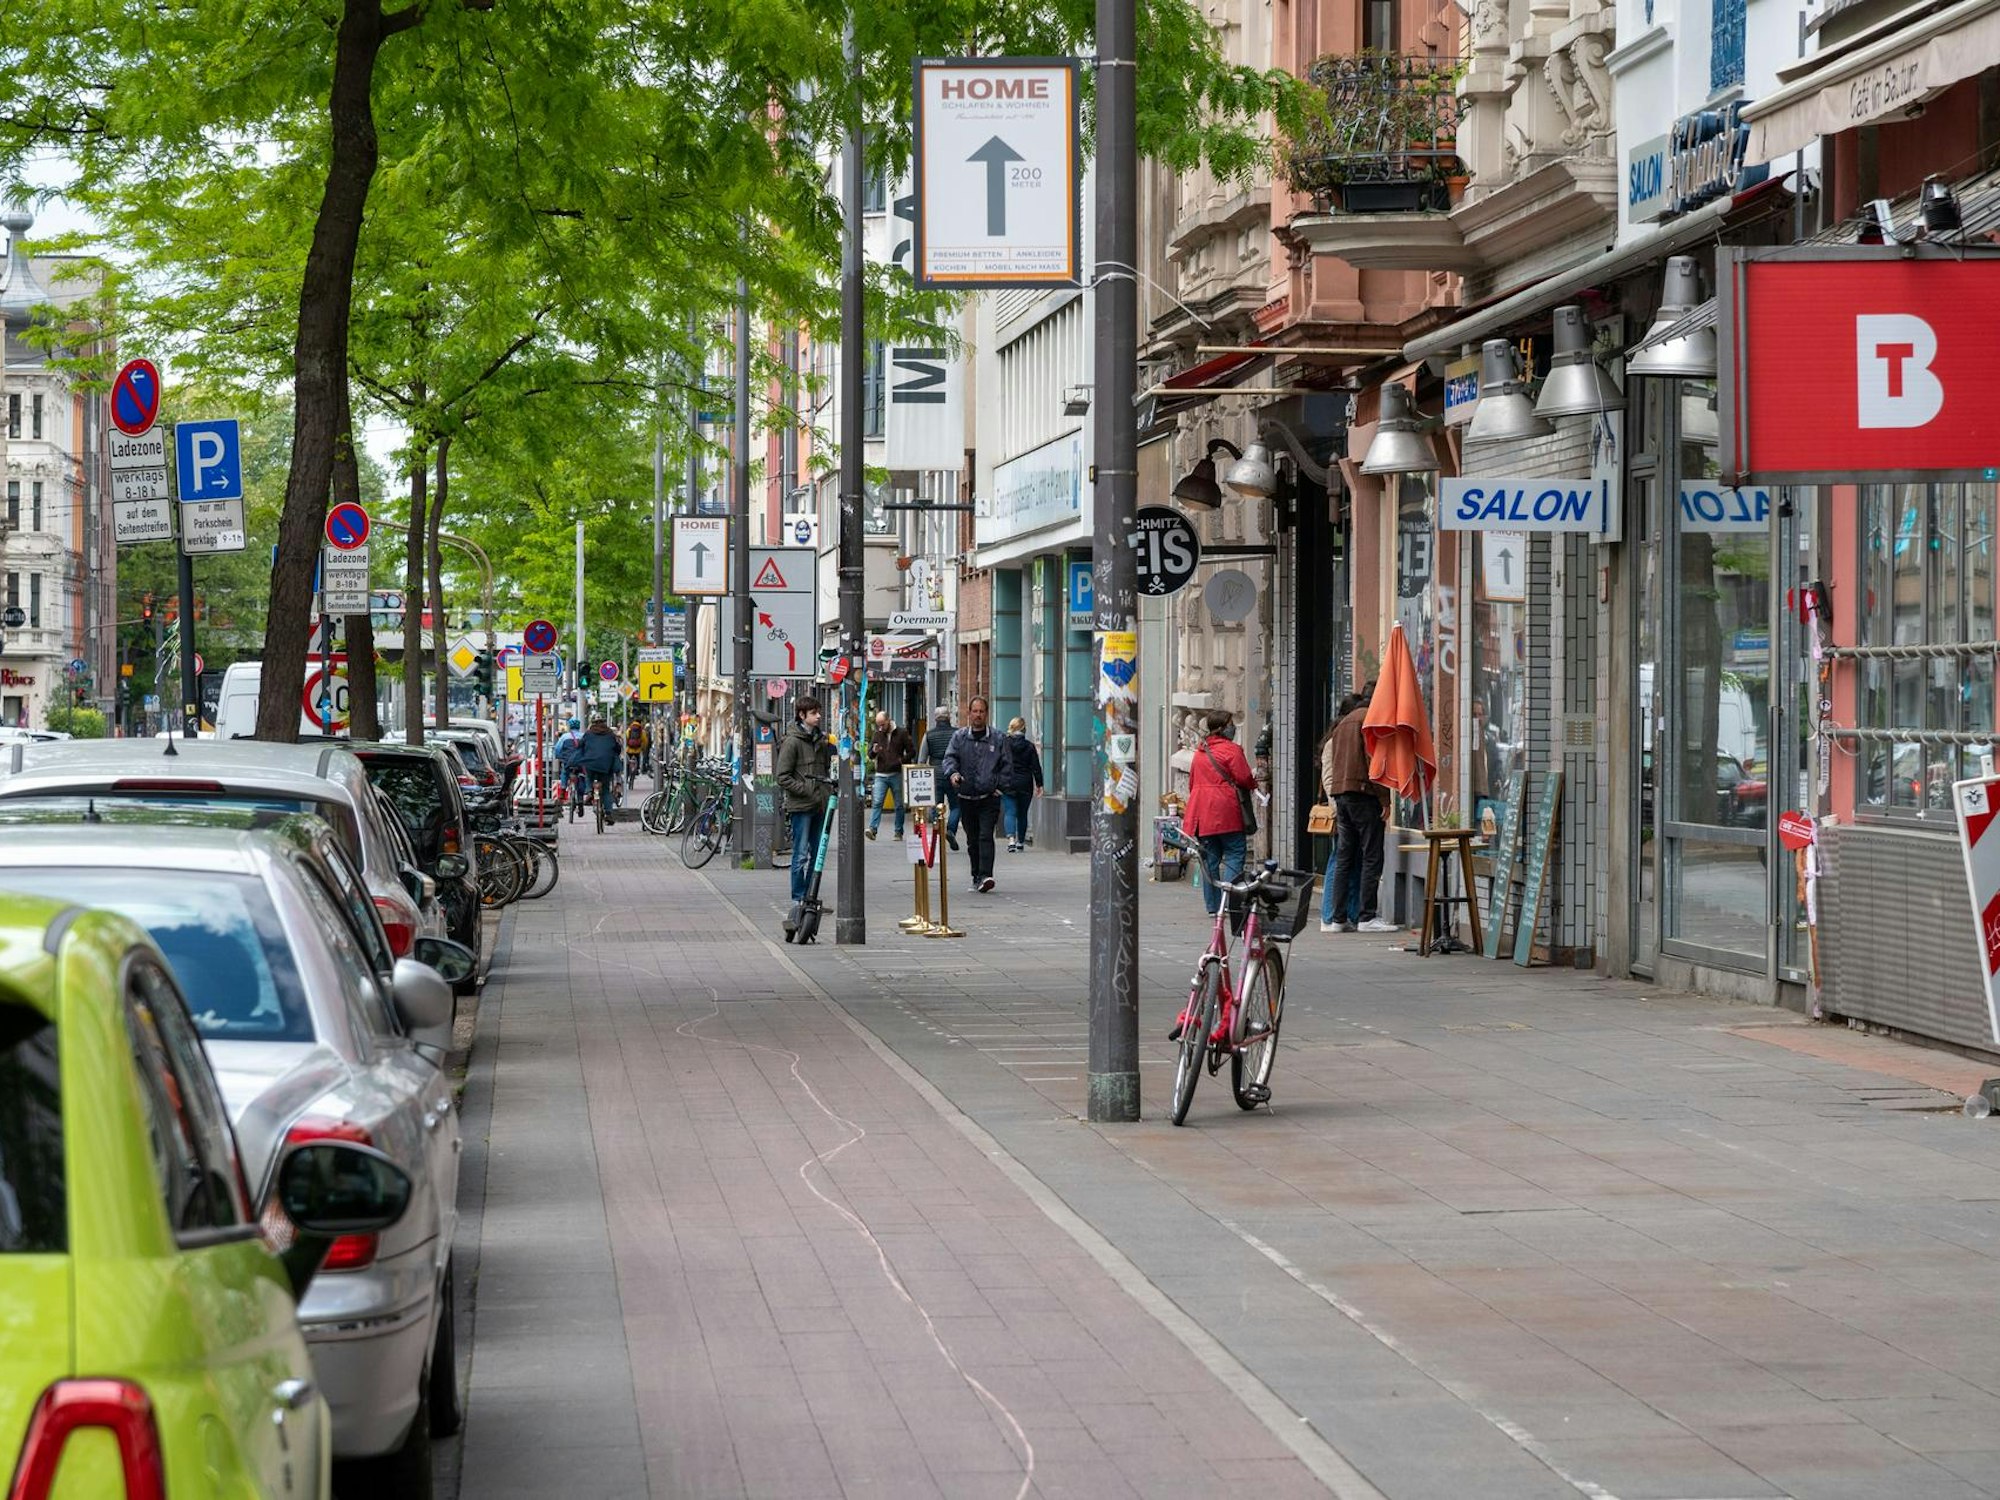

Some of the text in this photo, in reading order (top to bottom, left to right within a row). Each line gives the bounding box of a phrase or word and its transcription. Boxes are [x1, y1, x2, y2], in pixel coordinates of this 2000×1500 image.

[941, 78, 1049, 100] HOME
[1011, 167, 1042, 180] 200
[1629, 151, 1663, 206] SALON
[934, 263, 967, 271] KÜCHEN
[984, 263, 1061, 271] MÖBEL NACH MASS
[112, 440, 162, 458] Ladezone
[192, 431, 225, 490] P
[115, 470, 164, 483] werktags
[198, 502, 226, 512] nur mit
[1457, 488, 1592, 521] SALON
[127, 507, 158, 520] auf dem
[118, 521, 168, 535] Seitenstreifen
[194, 516, 233, 529] Parkschein
[680, 521, 720, 529] HOME
[187, 533, 217, 548] werktags
[328, 552, 367, 563] Ladezone
[329, 572, 366, 580] werktags
[327, 602, 366, 610] Seitenstreifen
[893, 615, 948, 625] Overmann
[653, 665, 660, 675] U
[911, 770, 932, 778] EIS
